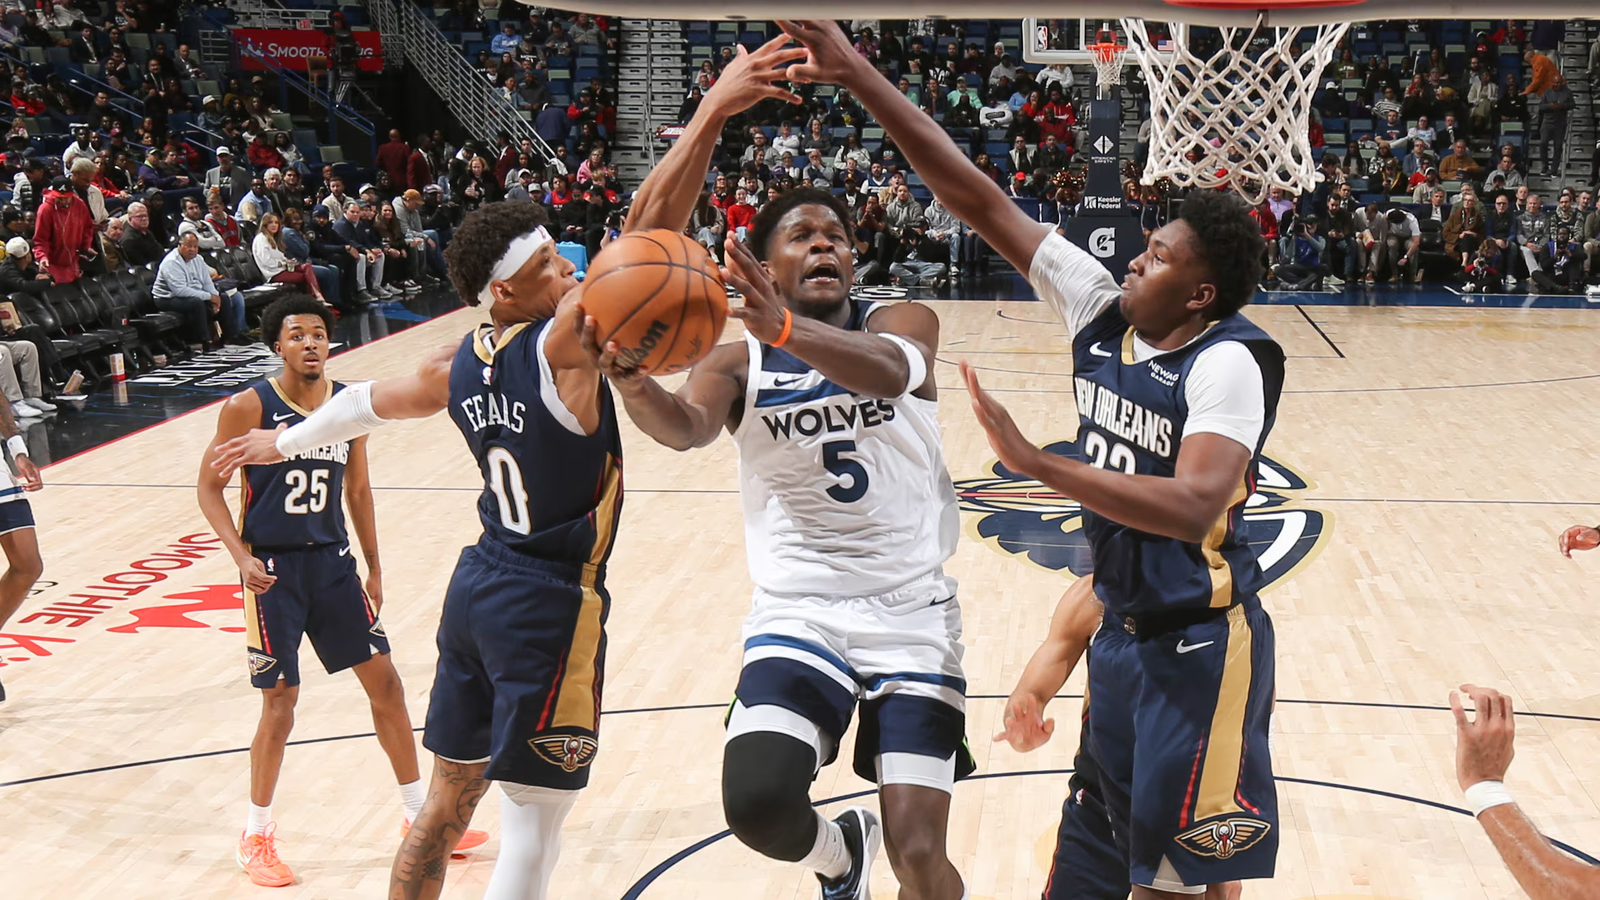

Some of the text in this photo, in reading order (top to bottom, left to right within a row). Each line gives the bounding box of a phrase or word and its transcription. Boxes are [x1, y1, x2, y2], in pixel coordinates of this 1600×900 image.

[268, 43, 331, 57] SMOOTH
[615, 320, 669, 367] ilson
[1148, 360, 1179, 381] NEWAG
[761, 399, 895, 441] WOLVES
[1094, 386, 1173, 457] ORLEANS
[284, 469, 329, 514] 25
[487, 447, 532, 535] 0
[822, 440, 869, 503] 5
